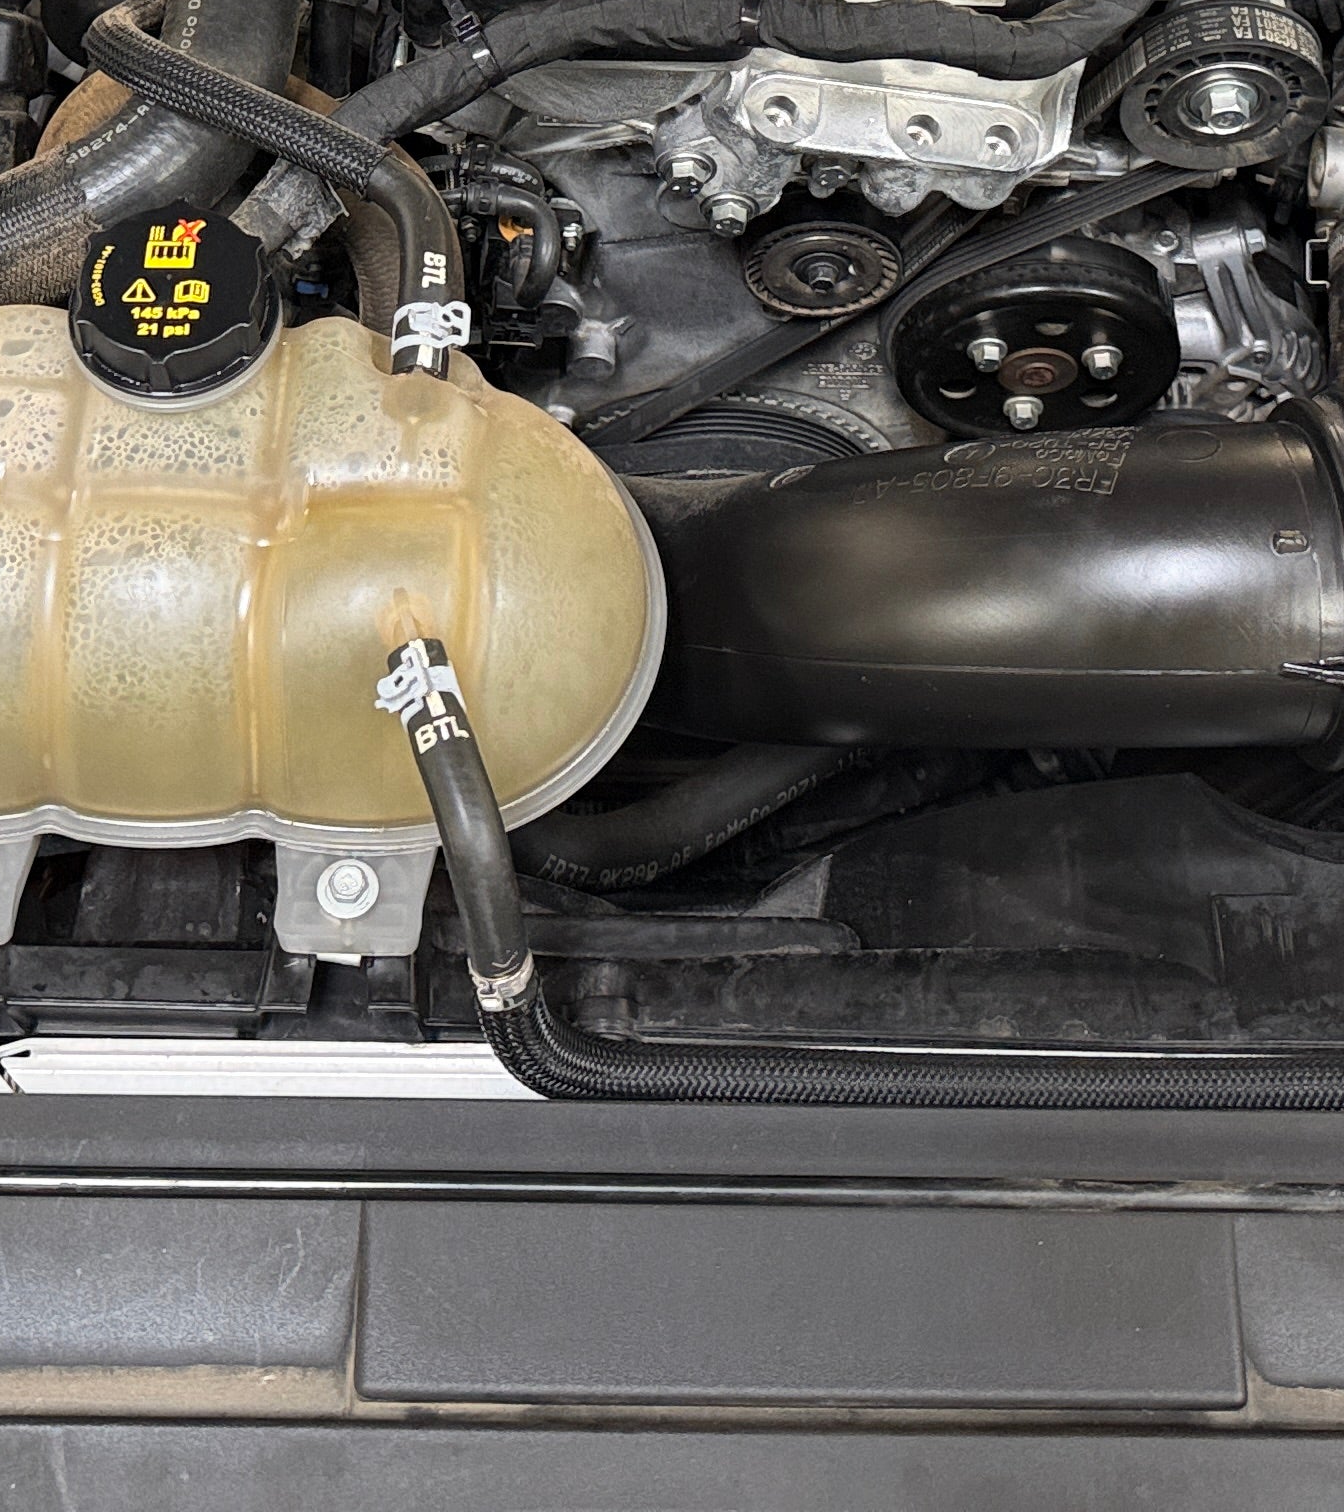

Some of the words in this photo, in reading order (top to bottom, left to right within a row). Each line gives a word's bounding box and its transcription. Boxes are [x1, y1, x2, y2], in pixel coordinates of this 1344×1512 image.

[1233, 26, 1254, 39] FA
[421, 251, 447, 289] BTL
[130, 306, 164, 320] 145
[165, 306, 201, 320] kPa
[136, 322, 159, 336] 21
[162, 322, 191, 338] psi
[414, 715, 471, 755] BTL
